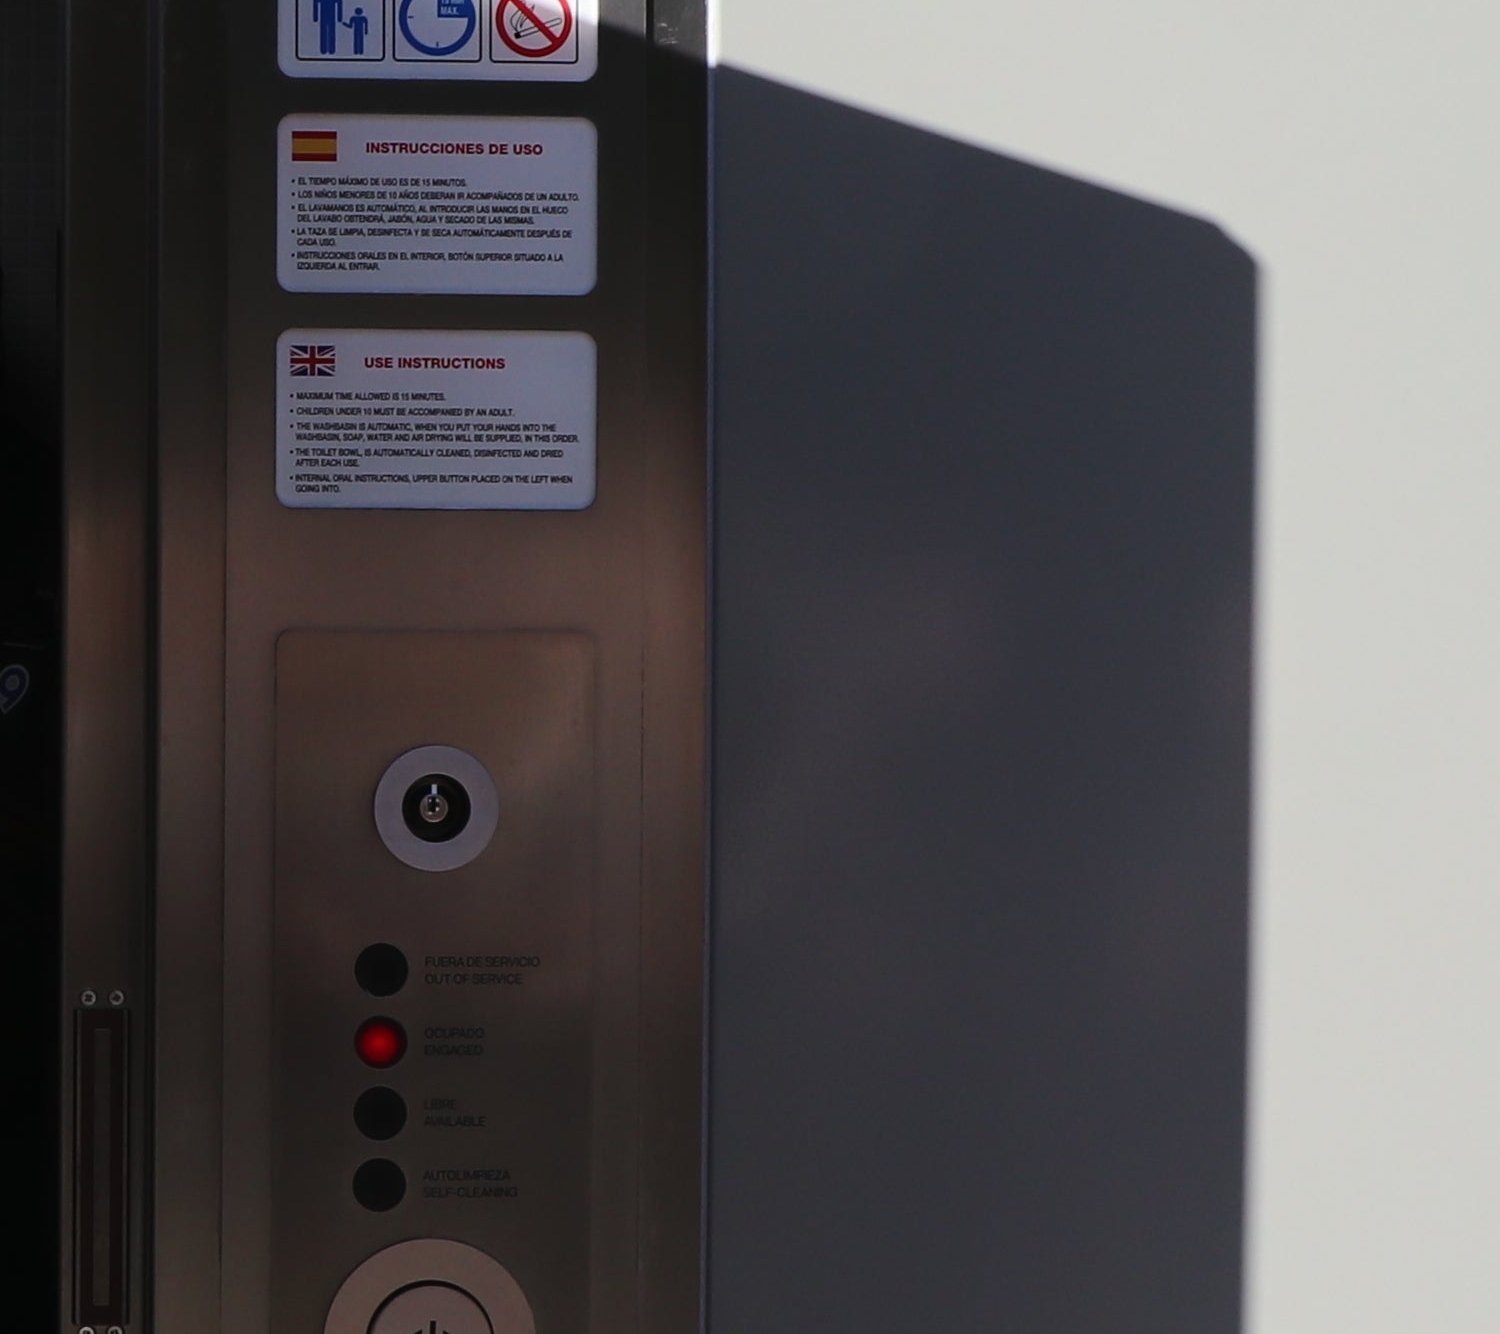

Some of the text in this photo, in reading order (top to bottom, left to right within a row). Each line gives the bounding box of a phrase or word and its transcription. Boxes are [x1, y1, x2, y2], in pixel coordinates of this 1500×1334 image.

[365, 142, 544, 156] INSTRUCCIONES DE USO
[364, 357, 506, 370] USE INSTRUCTIONS
[424, 955, 541, 968] FUERA DE SERVICIO
[424, 973, 524, 985] OUT OF SERVICE
[424, 1026, 485, 1039] OCUPADO
[423, 1115, 486, 1127] AVAILABLE
[422, 1169, 511, 1181] AUTOLIMPIEZA
[423, 1186, 519, 1199] SELF-CLEANING
